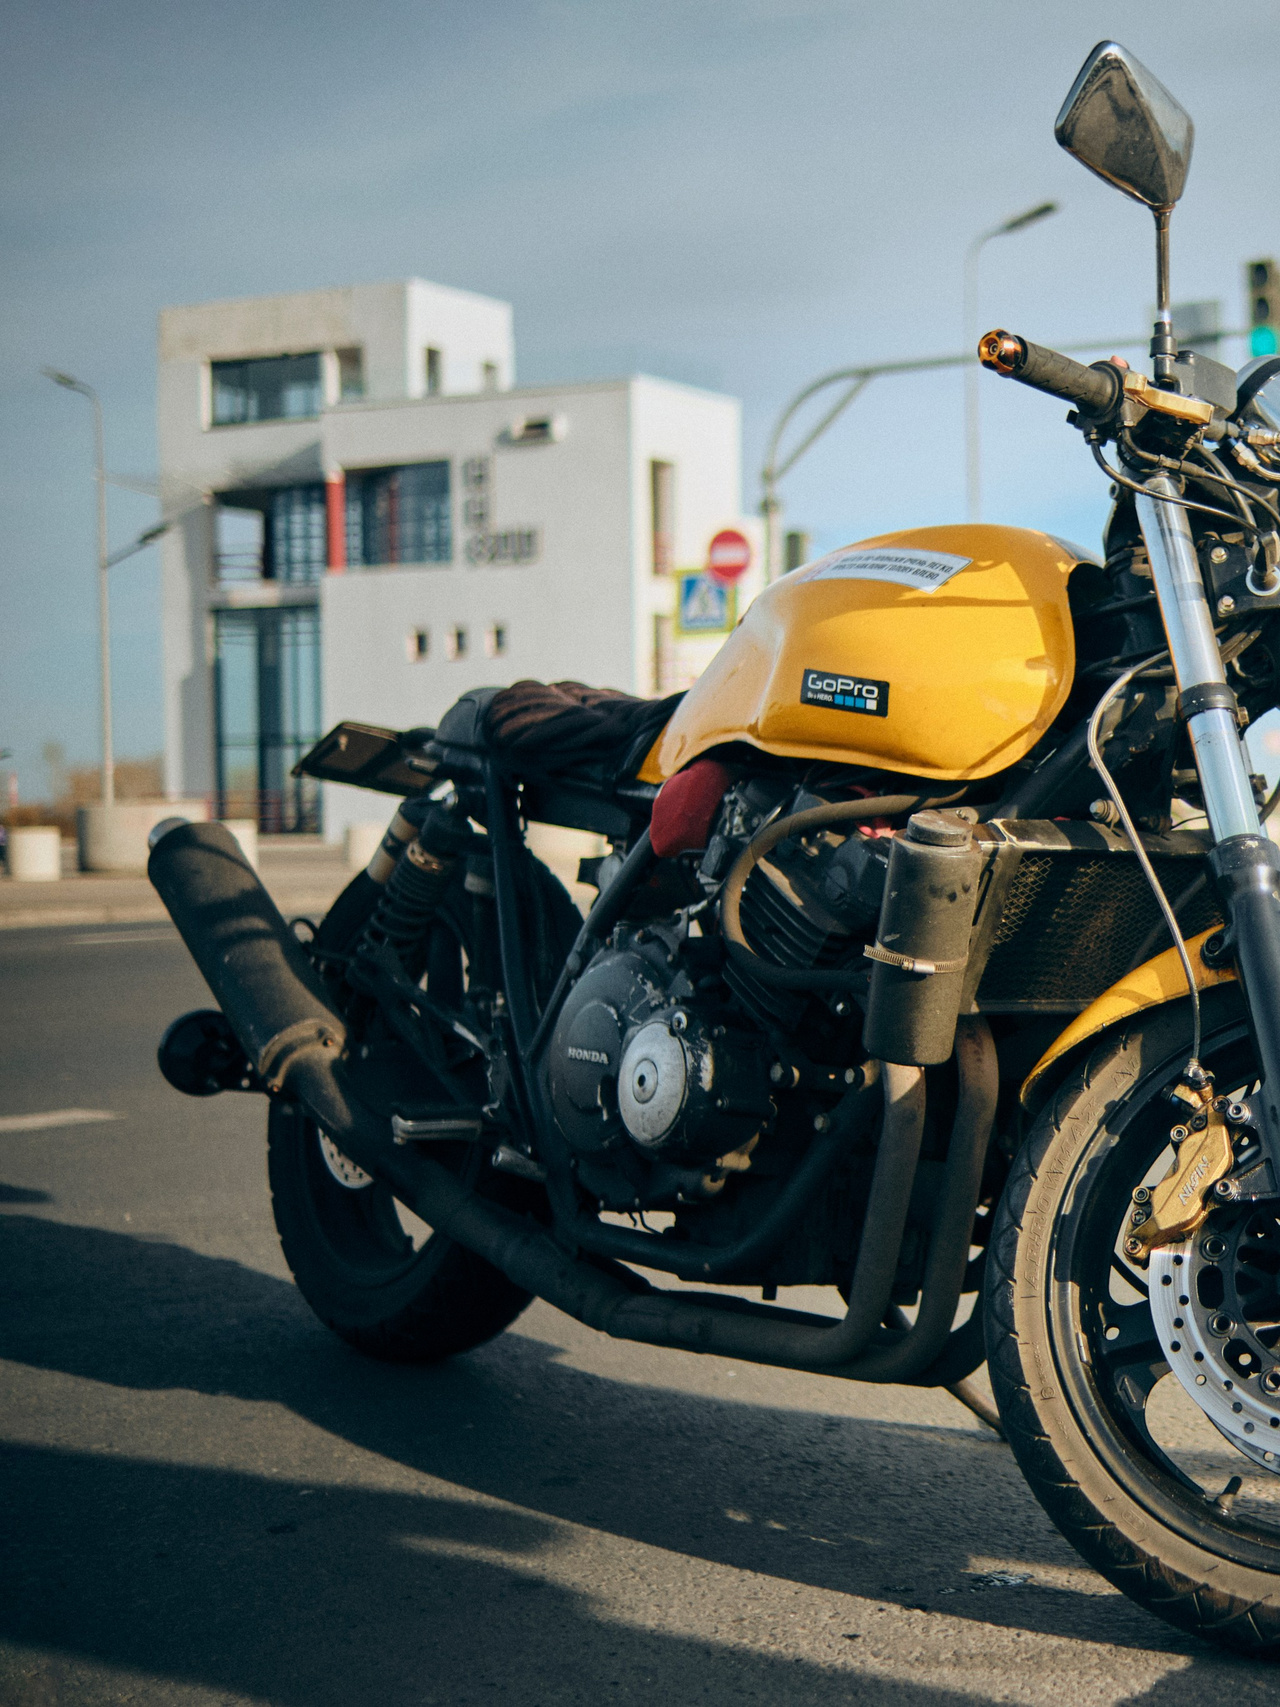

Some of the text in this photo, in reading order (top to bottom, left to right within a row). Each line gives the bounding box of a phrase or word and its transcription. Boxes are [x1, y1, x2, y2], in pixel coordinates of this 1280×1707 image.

[911, 568, 940, 580] ВЛЕВО
[807, 674, 879, 698] GoPro
[568, 1046, 609, 1065] HONDA
